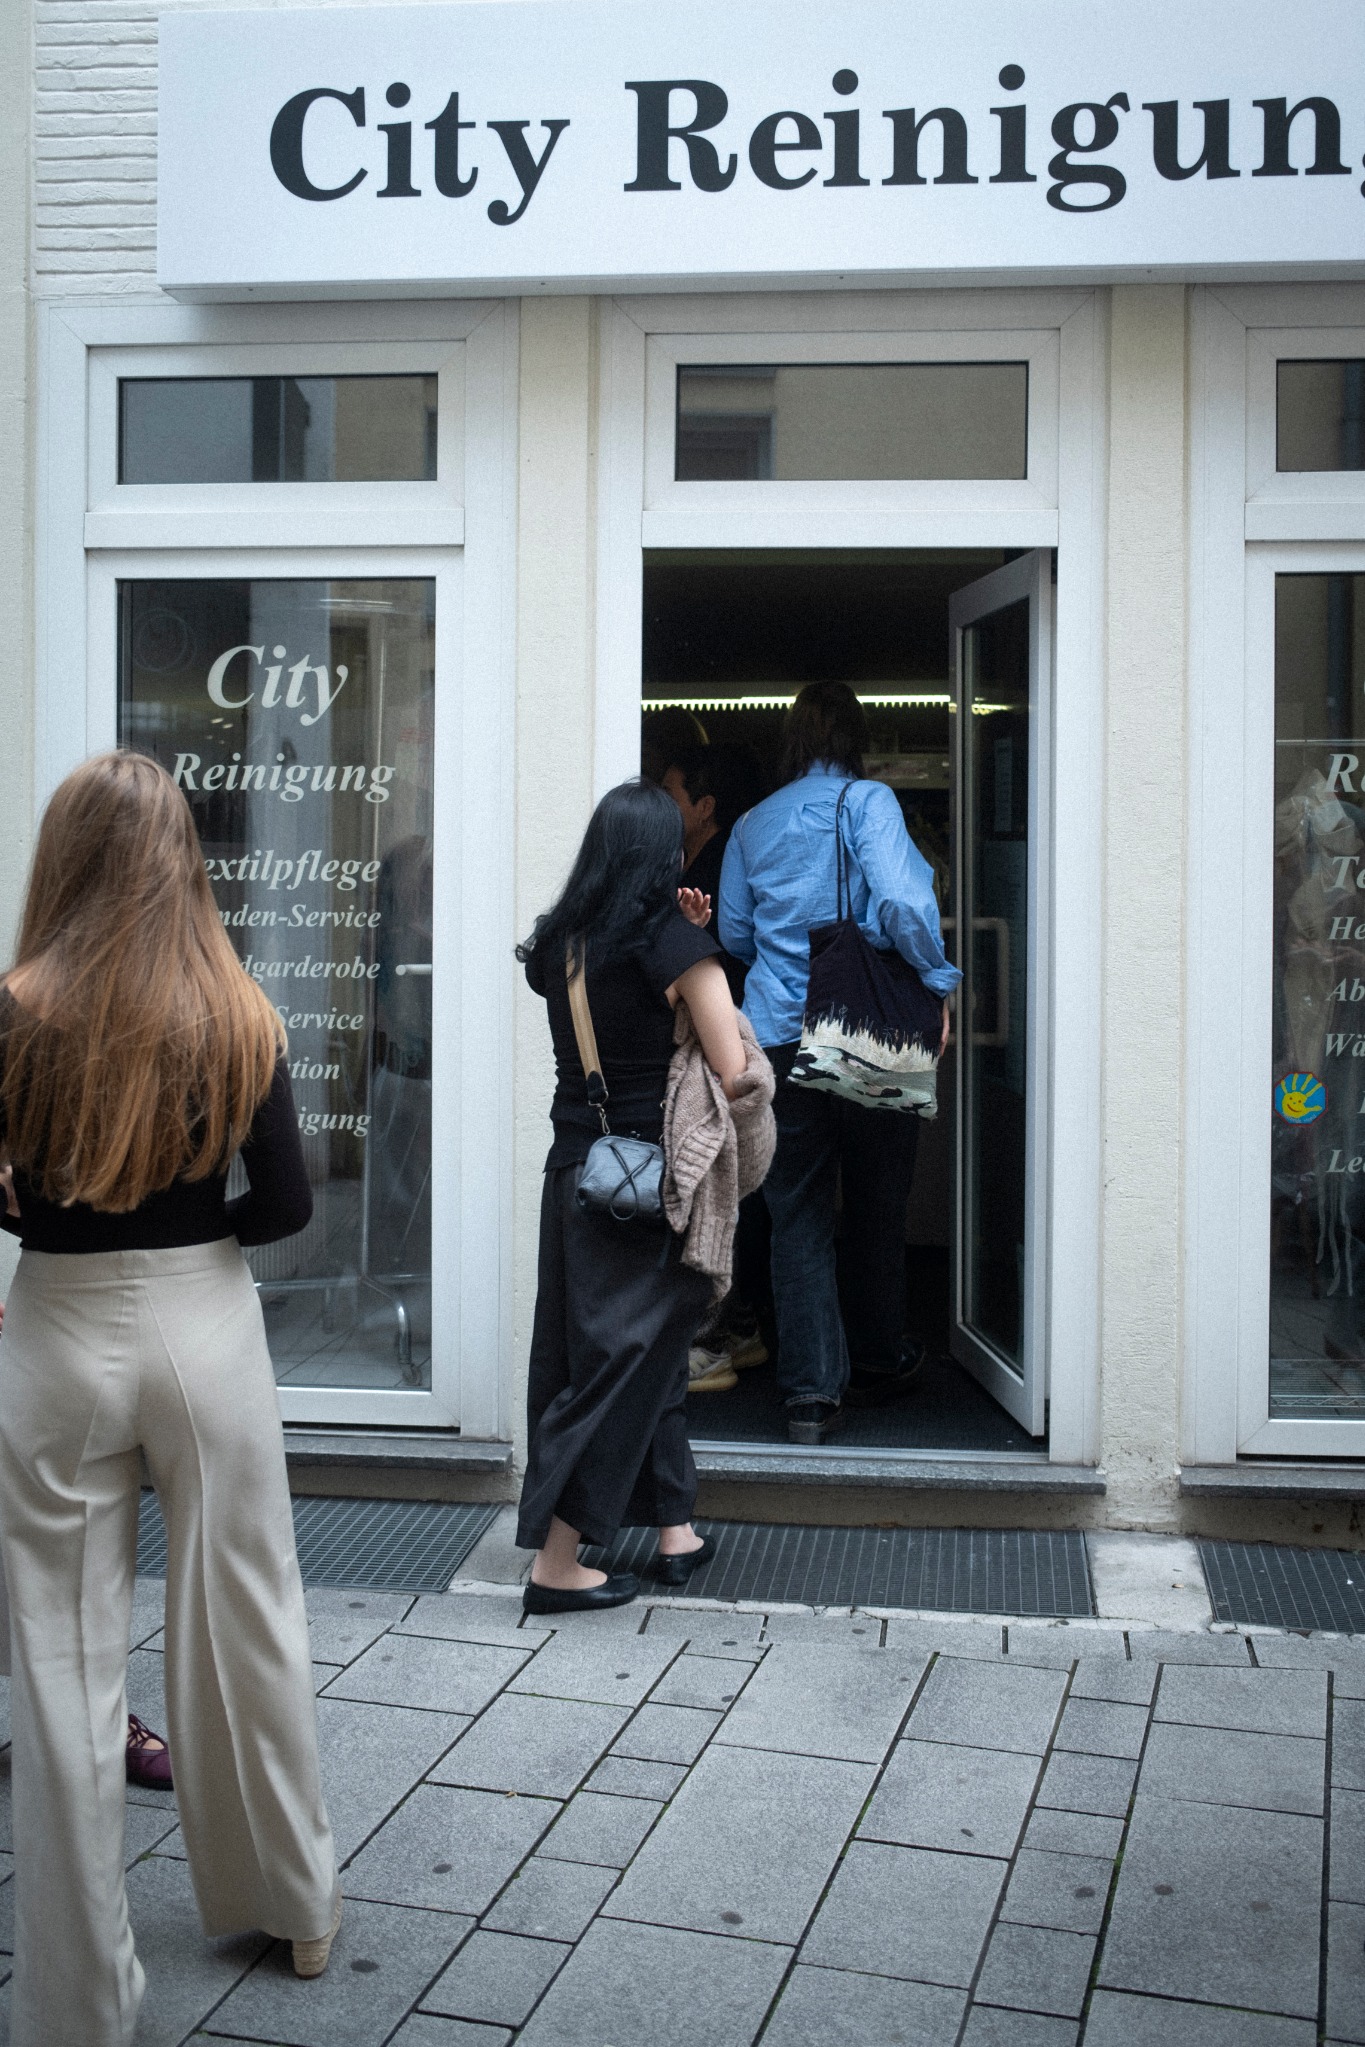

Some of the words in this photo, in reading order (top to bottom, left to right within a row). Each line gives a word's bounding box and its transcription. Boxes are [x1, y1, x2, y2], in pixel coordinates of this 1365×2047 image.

[269, 82, 570, 225] City
[623, 63, 1365, 213] Reinigun
[207, 644, 348, 726] City
[172, 752, 396, 803] Reinigung
[1326, 753, 1365, 793] R
[204, 849, 381, 891] extilpflege
[218, 903, 381, 928] nden-Service
[241, 954, 381, 985] dgarderobe
[275, 1005, 364, 1031] Service
[287, 1056, 340, 1081] tion
[298, 1105, 372, 1138] igung
[1326, 1148, 1365, 1174] Le
